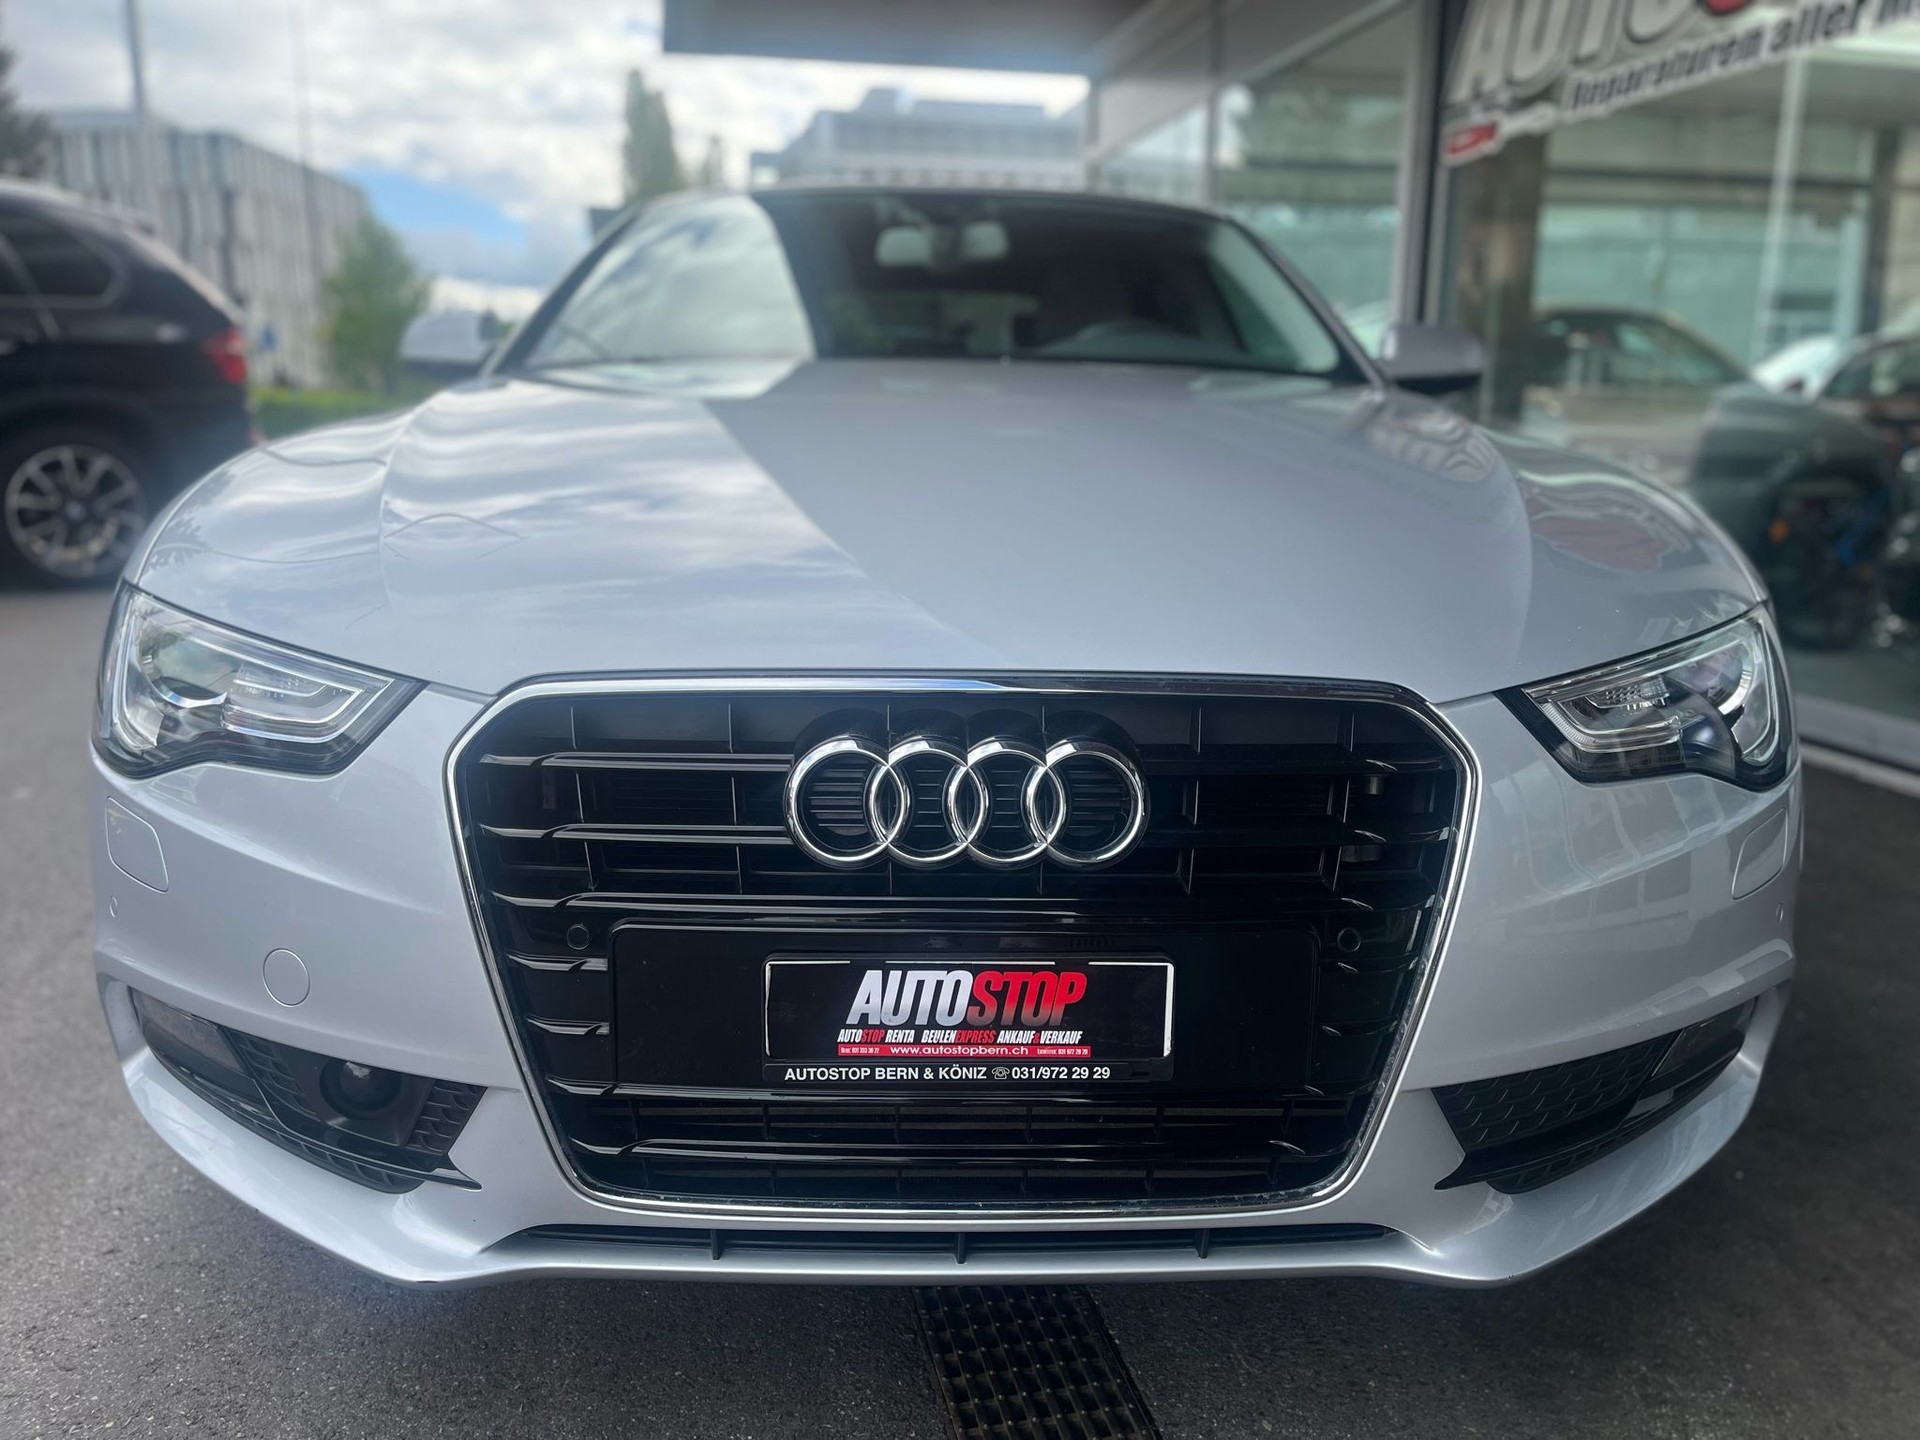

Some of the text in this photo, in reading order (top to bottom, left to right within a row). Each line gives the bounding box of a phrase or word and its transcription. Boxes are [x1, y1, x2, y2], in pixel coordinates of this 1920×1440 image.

[846, 969, 1087, 1026] AUTOSTOP
[837, 1029, 885, 1043] AUTOSTOP
[885, 1029, 915, 1043] RENTA
[921, 1030, 996, 1044] BEULENEXPRESS
[890, 1045, 1029, 1056] www.autostopbern.ch
[784, 1064, 1111, 1080] AUTOSTOP BERN & KÖNIZ 031/972 29 29
